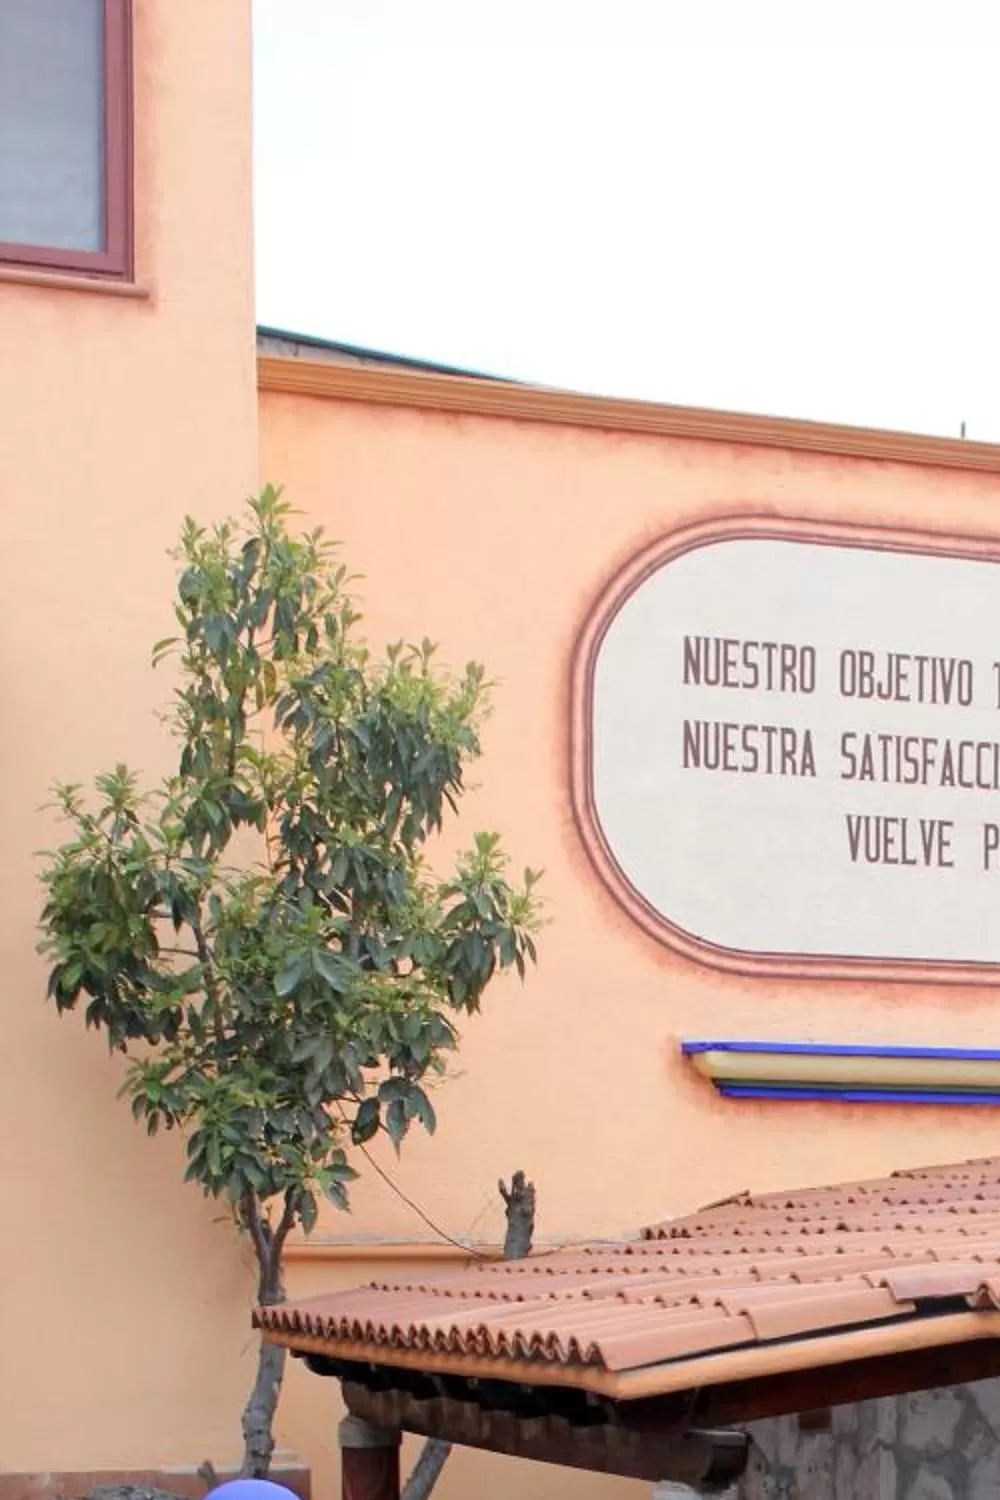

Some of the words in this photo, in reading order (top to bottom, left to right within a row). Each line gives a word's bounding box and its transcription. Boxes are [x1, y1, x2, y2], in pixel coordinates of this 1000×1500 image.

[682, 634, 817, 695] NUESTRO
[839, 649, 974, 707] OBJETIVO
[682, 719, 817, 778] NUESTRA
[845, 813, 955, 869] VUELVE
